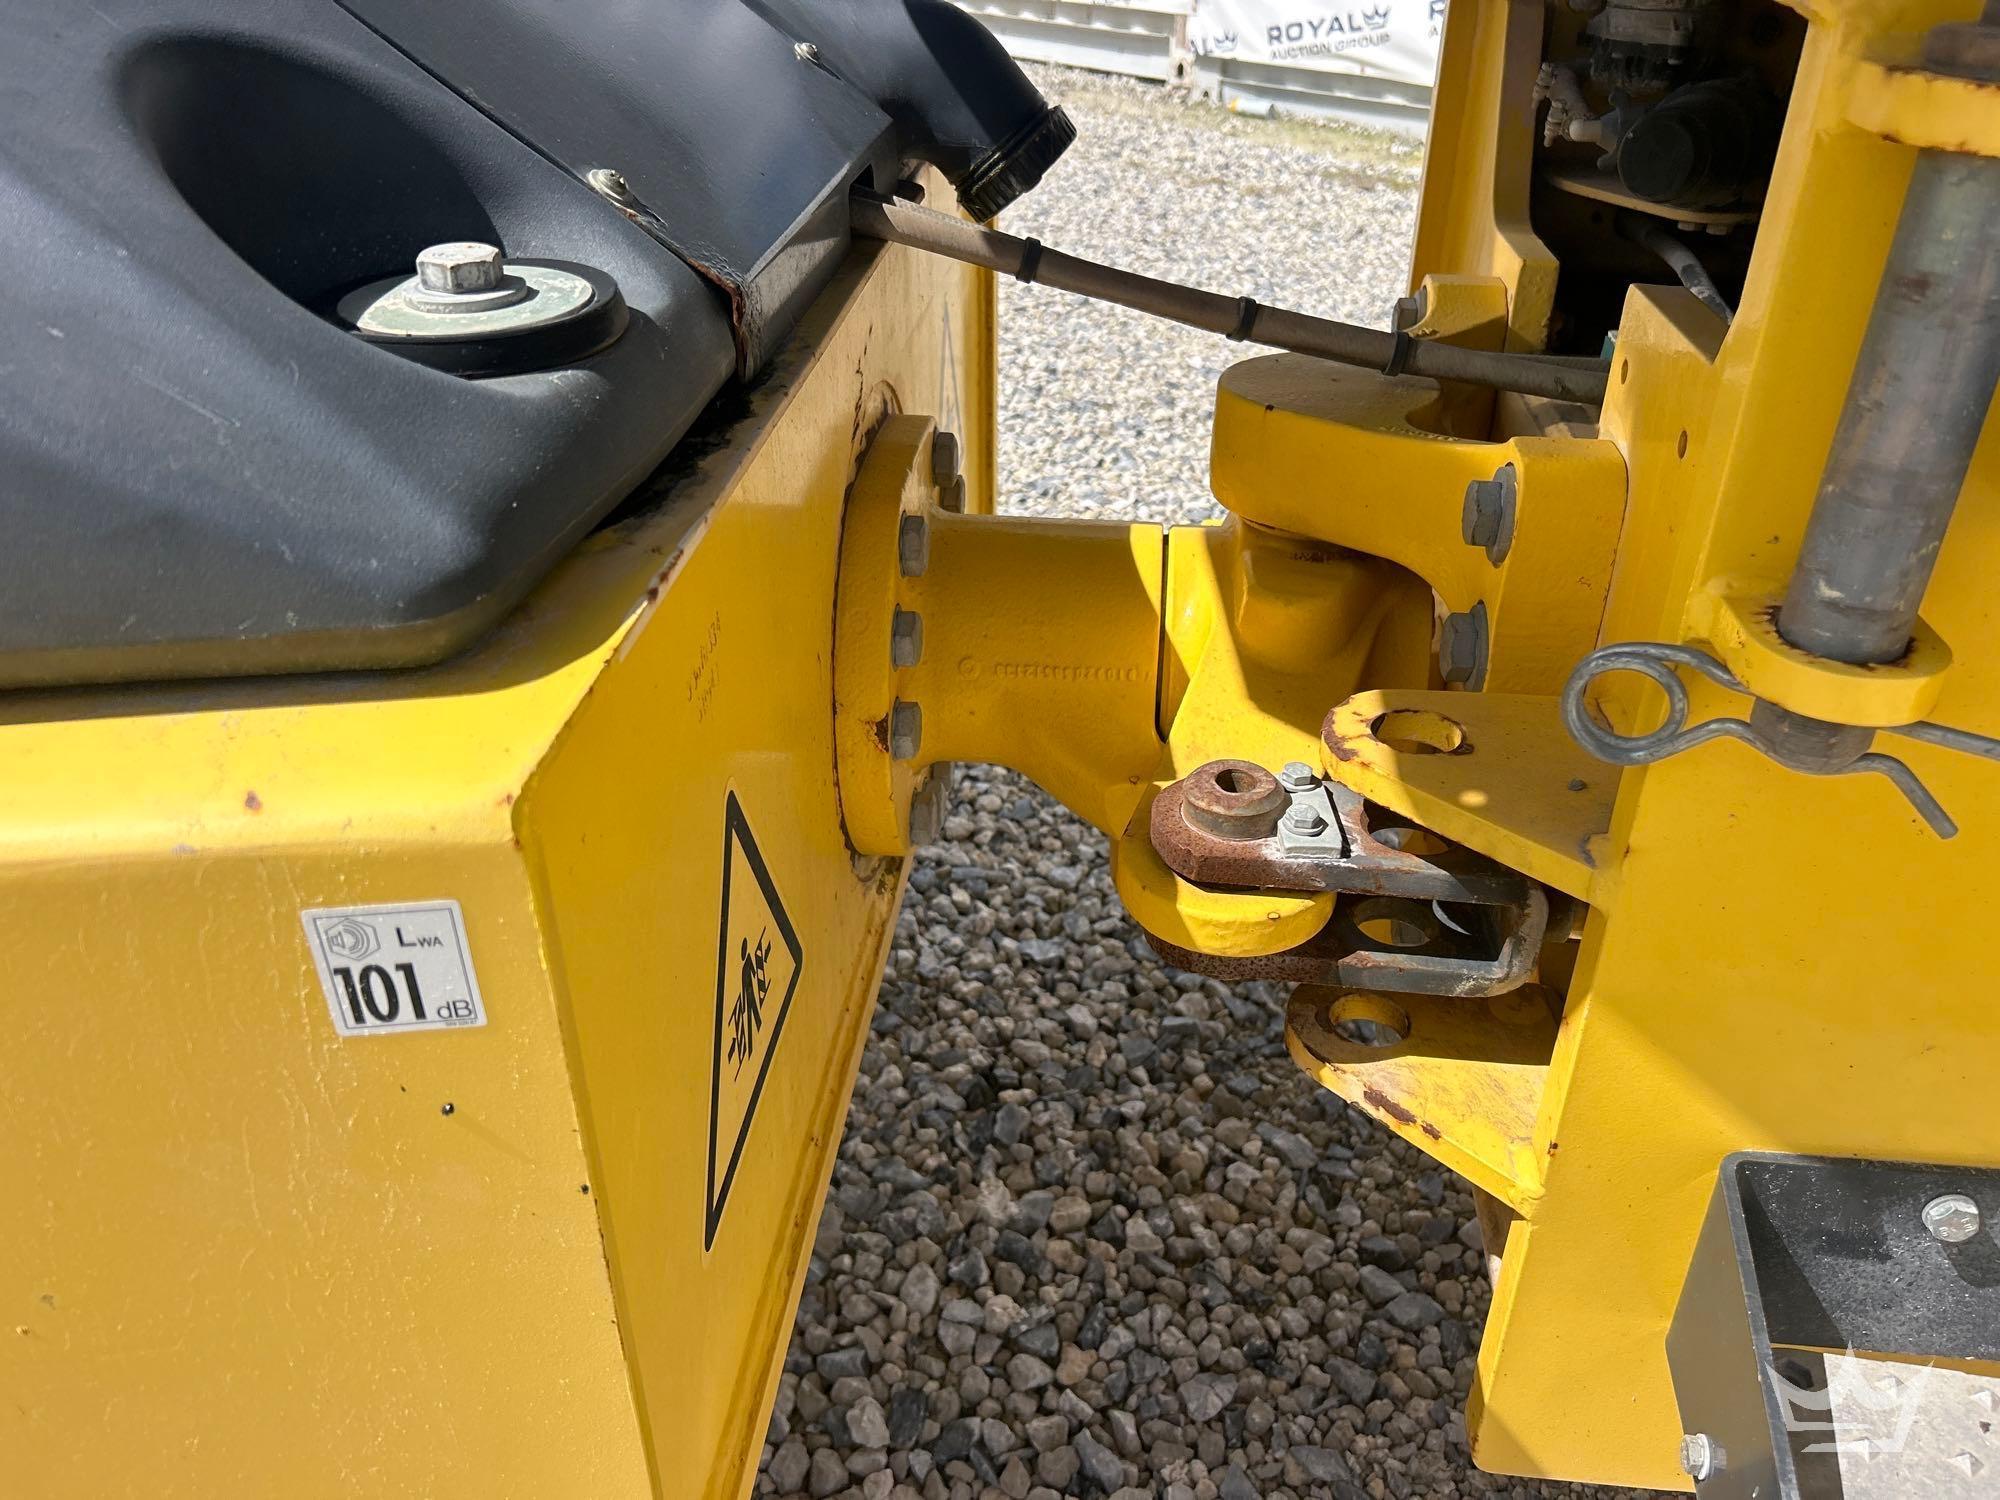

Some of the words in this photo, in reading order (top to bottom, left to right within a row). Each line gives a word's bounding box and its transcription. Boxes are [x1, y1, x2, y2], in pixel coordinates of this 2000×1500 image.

[1266, 13, 1362, 45] ROYAL
[1271, 42, 1332, 61] AUCTION
[1335, 33, 1392, 52] GROUP
[333, 962, 427, 1025] 101
[437, 999, 472, 1019] dB
